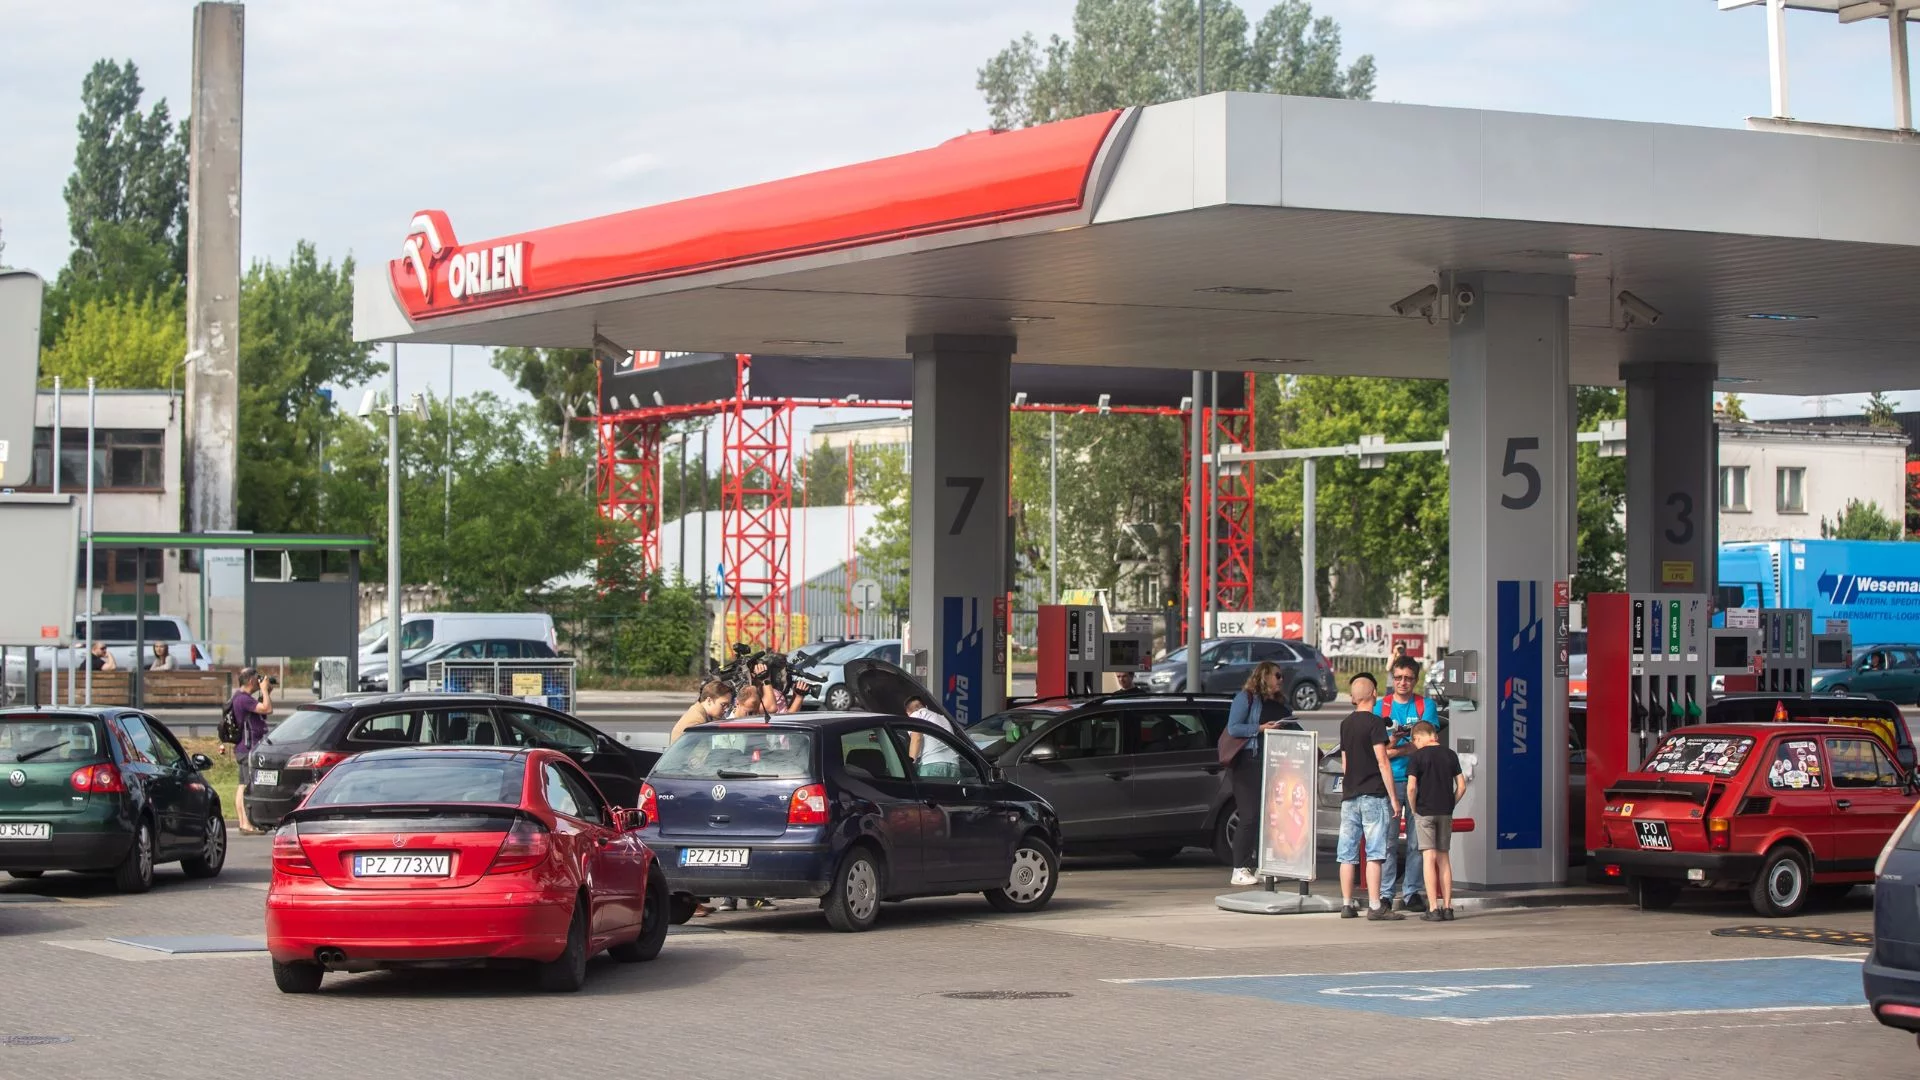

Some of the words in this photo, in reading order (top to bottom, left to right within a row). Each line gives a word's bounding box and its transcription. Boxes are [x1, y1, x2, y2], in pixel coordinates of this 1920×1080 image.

[448, 242, 523, 299] ORLEN
[1501, 437, 1541, 510] 5
[945, 476, 985, 536] 7
[1665, 492, 1694, 545] 3
[1857, 577, 1920, 592] Wesema
[1217, 622, 1245, 634] BEX
[956, 674, 969, 727] erva
[1513, 676, 1528, 755] verva
[11, 824, 45, 836] 5KL71
[1642, 822, 1658, 834] PO
[1640, 834, 1669, 848] 1HW41
[688, 849, 704, 863] PZ
[707, 849, 745, 863] 715TY
[365, 857, 387, 874] PZ
[393, 857, 445, 874] 773XV
